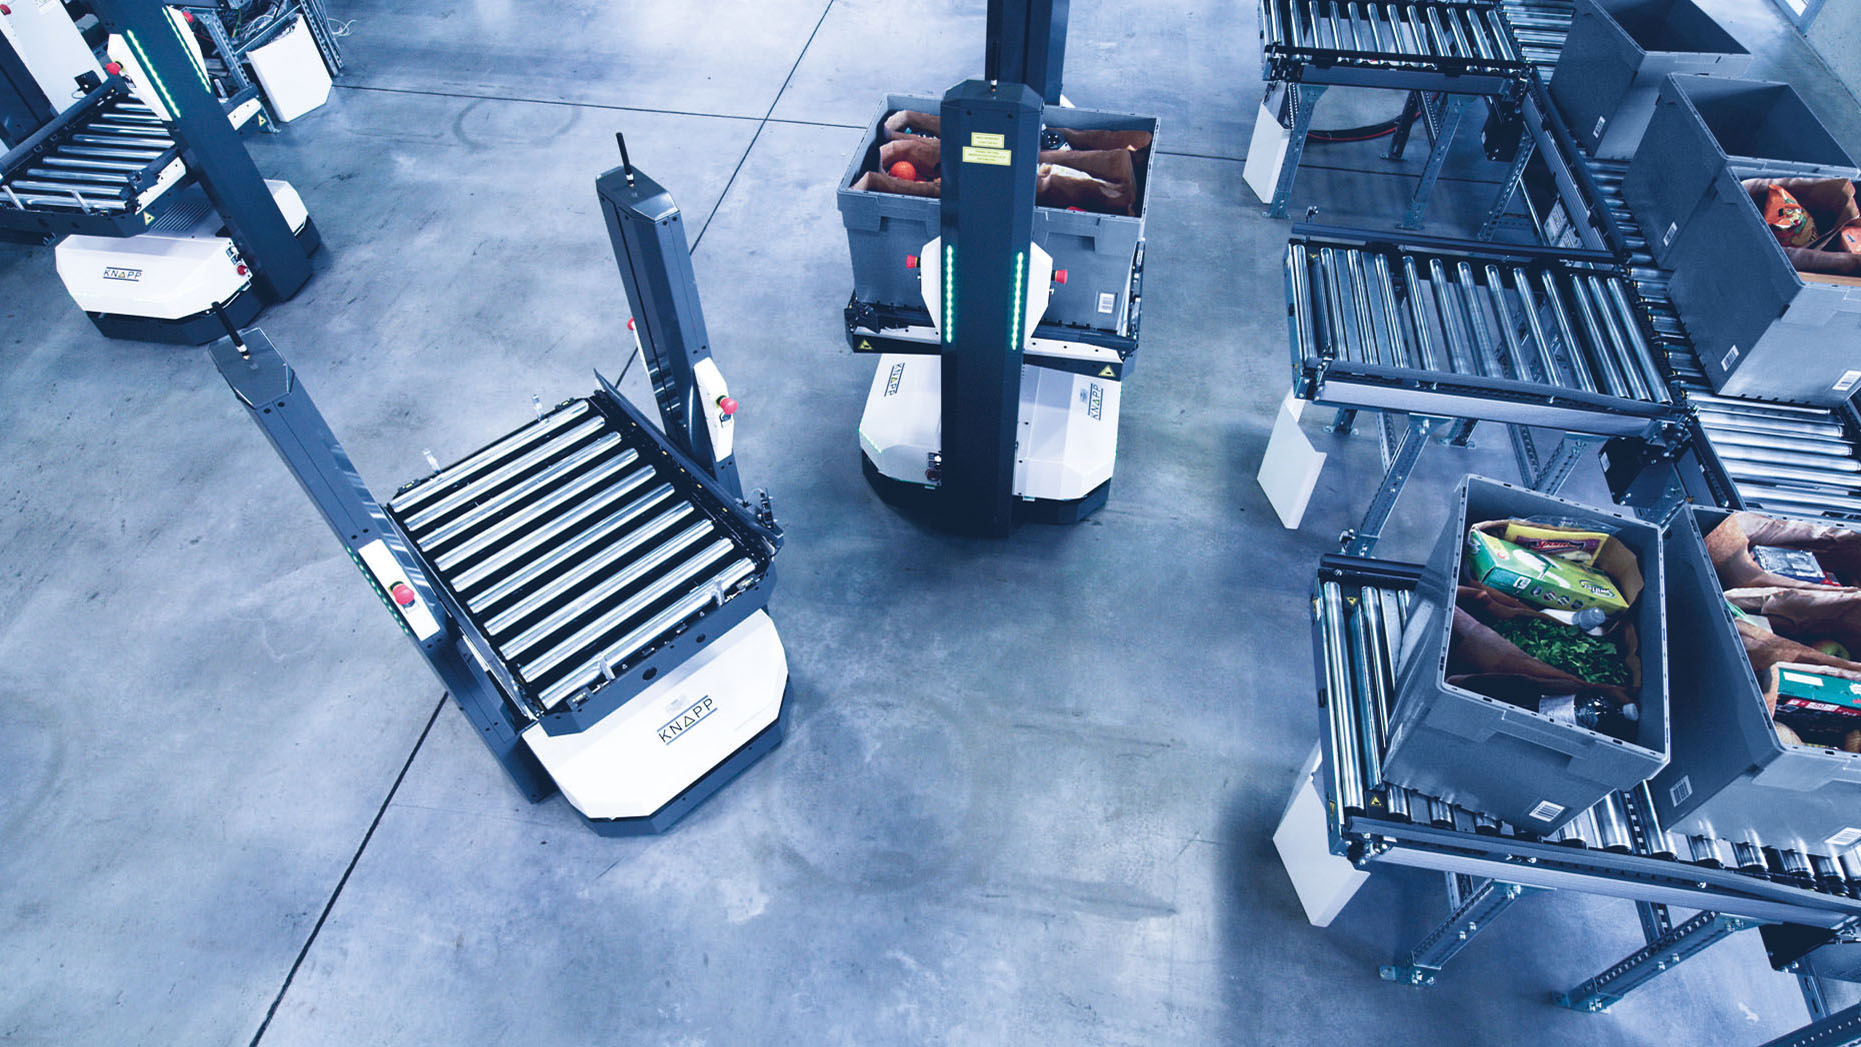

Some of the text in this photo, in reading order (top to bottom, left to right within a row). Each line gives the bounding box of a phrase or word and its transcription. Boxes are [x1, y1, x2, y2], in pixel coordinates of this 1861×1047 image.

[103, 268, 142, 280] KNAPP
[887, 363, 902, 396] KNAPP
[1090, 383, 1101, 420] KNAPP
[658, 698, 713, 743] KNAPP
